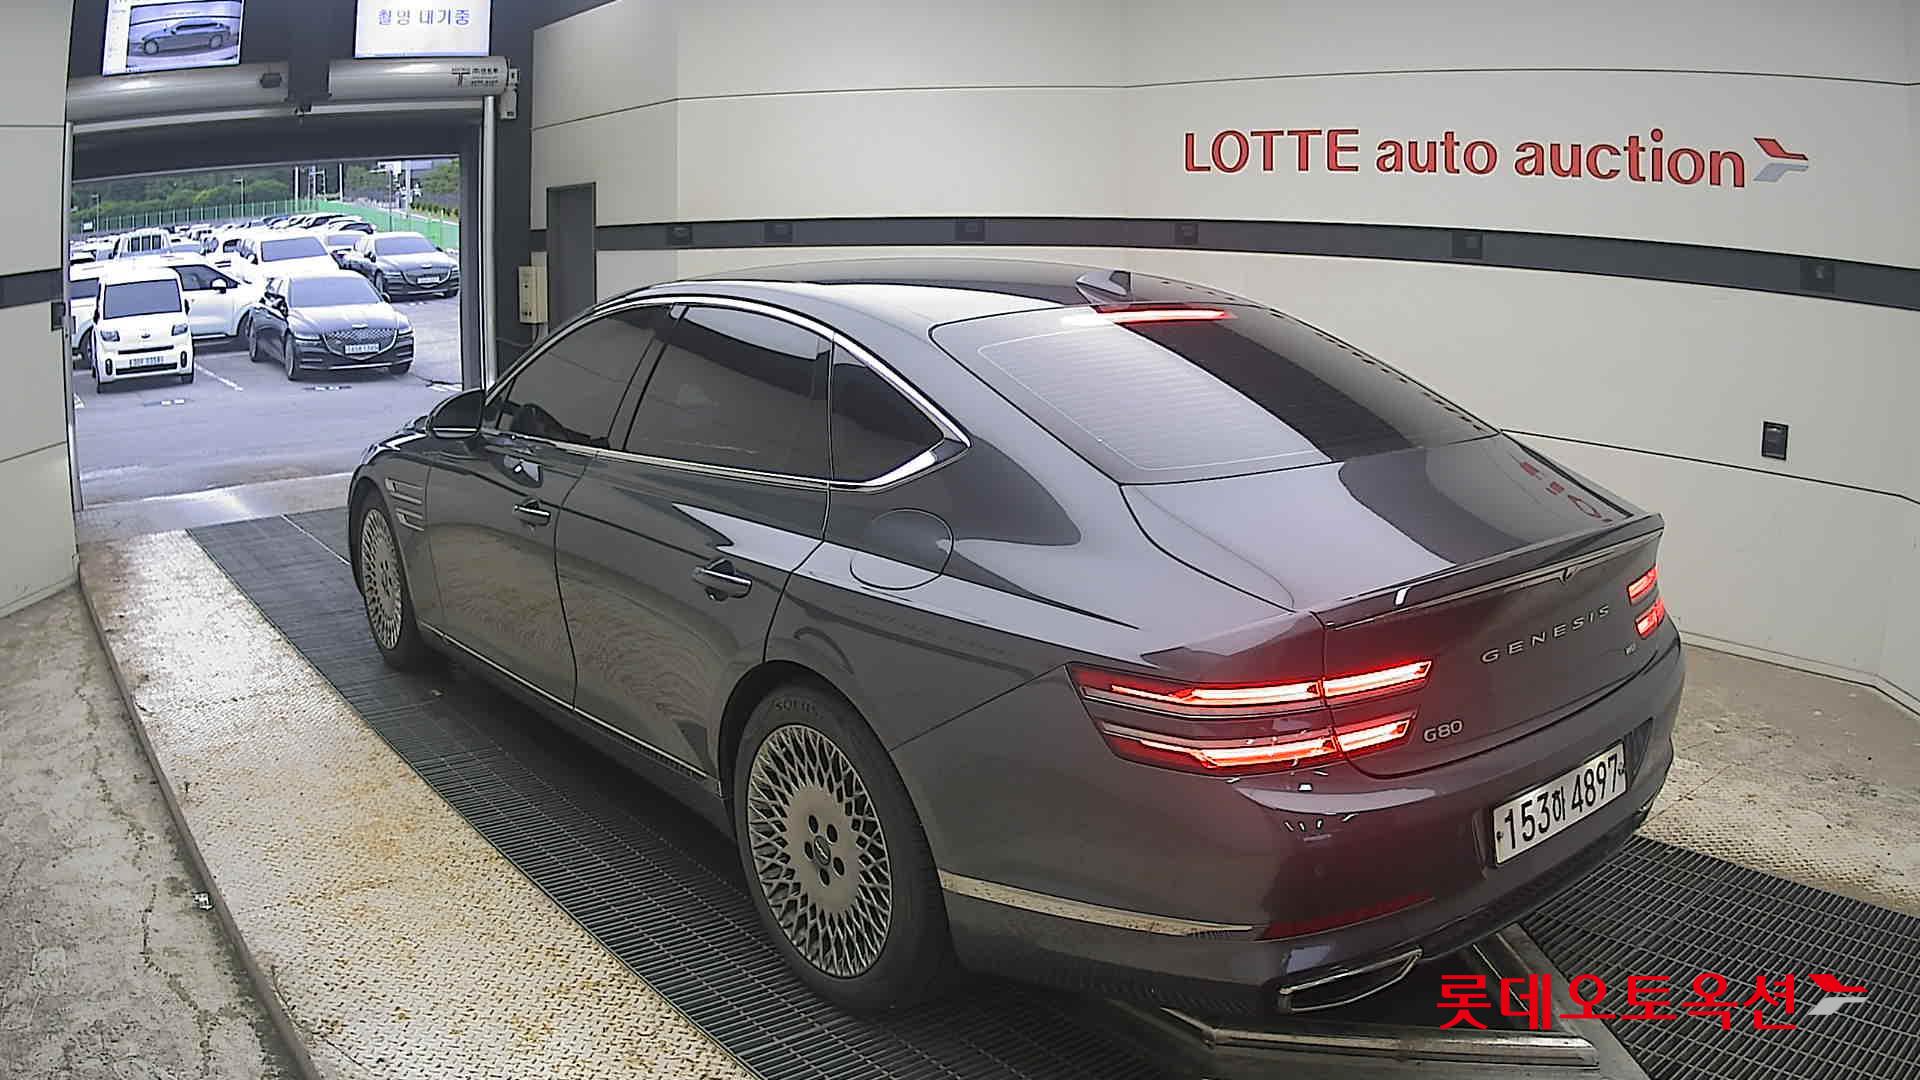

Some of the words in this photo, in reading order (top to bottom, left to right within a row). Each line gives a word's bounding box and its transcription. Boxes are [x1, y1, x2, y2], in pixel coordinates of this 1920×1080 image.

[419, 9, 470, 25] 대기중
[1184, 128, 1360, 173] LOTTE
[1376, 130, 1497, 175] auto
[1514, 128, 1746, 188] auction
[1481, 604, 1609, 664] GENESIS
[1423, 720, 1463, 743] G80
